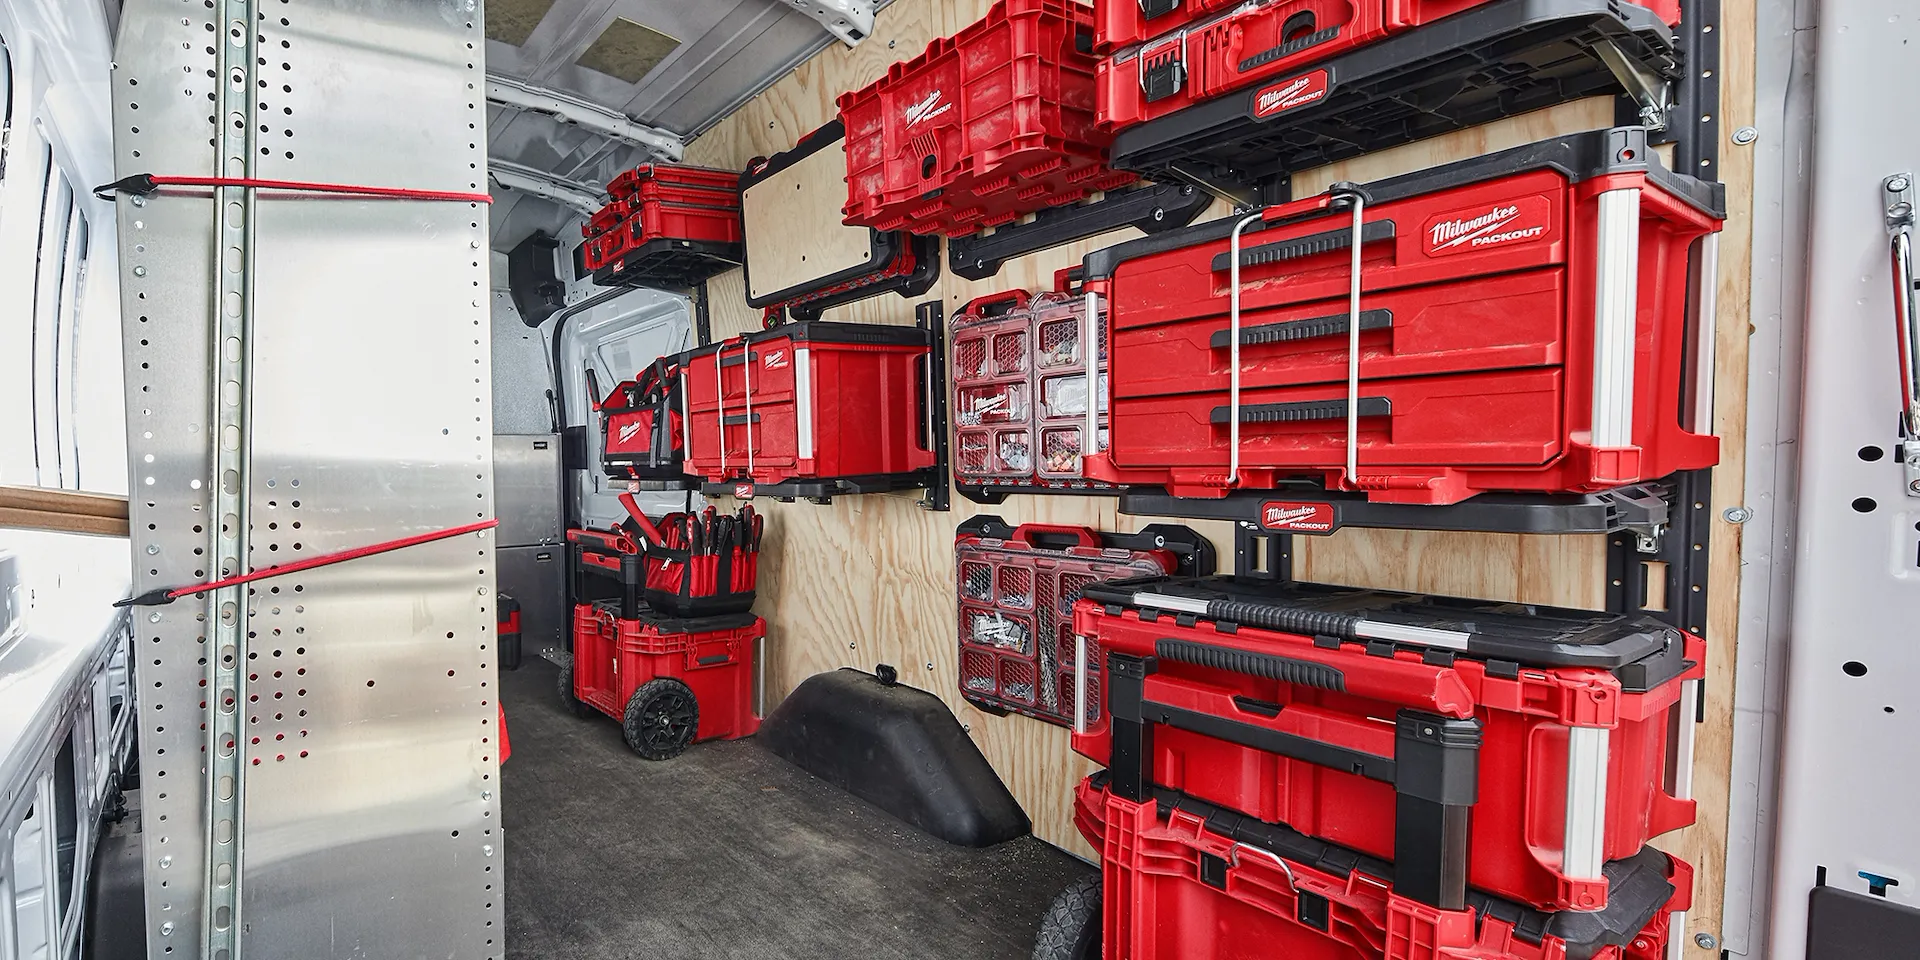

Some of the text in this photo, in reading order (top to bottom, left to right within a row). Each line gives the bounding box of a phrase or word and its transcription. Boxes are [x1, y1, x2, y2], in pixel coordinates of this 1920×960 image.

[1258, 78, 1311, 110] Milwaukee
[1282, 90, 1324, 108] PACKOUT
[1428, 205, 1519, 245] Milwaukee
[1471, 226, 1543, 247] PACKOUT
[1265, 505, 1317, 521] Milwaukee
[1290, 522, 1330, 530] PACKOUT
